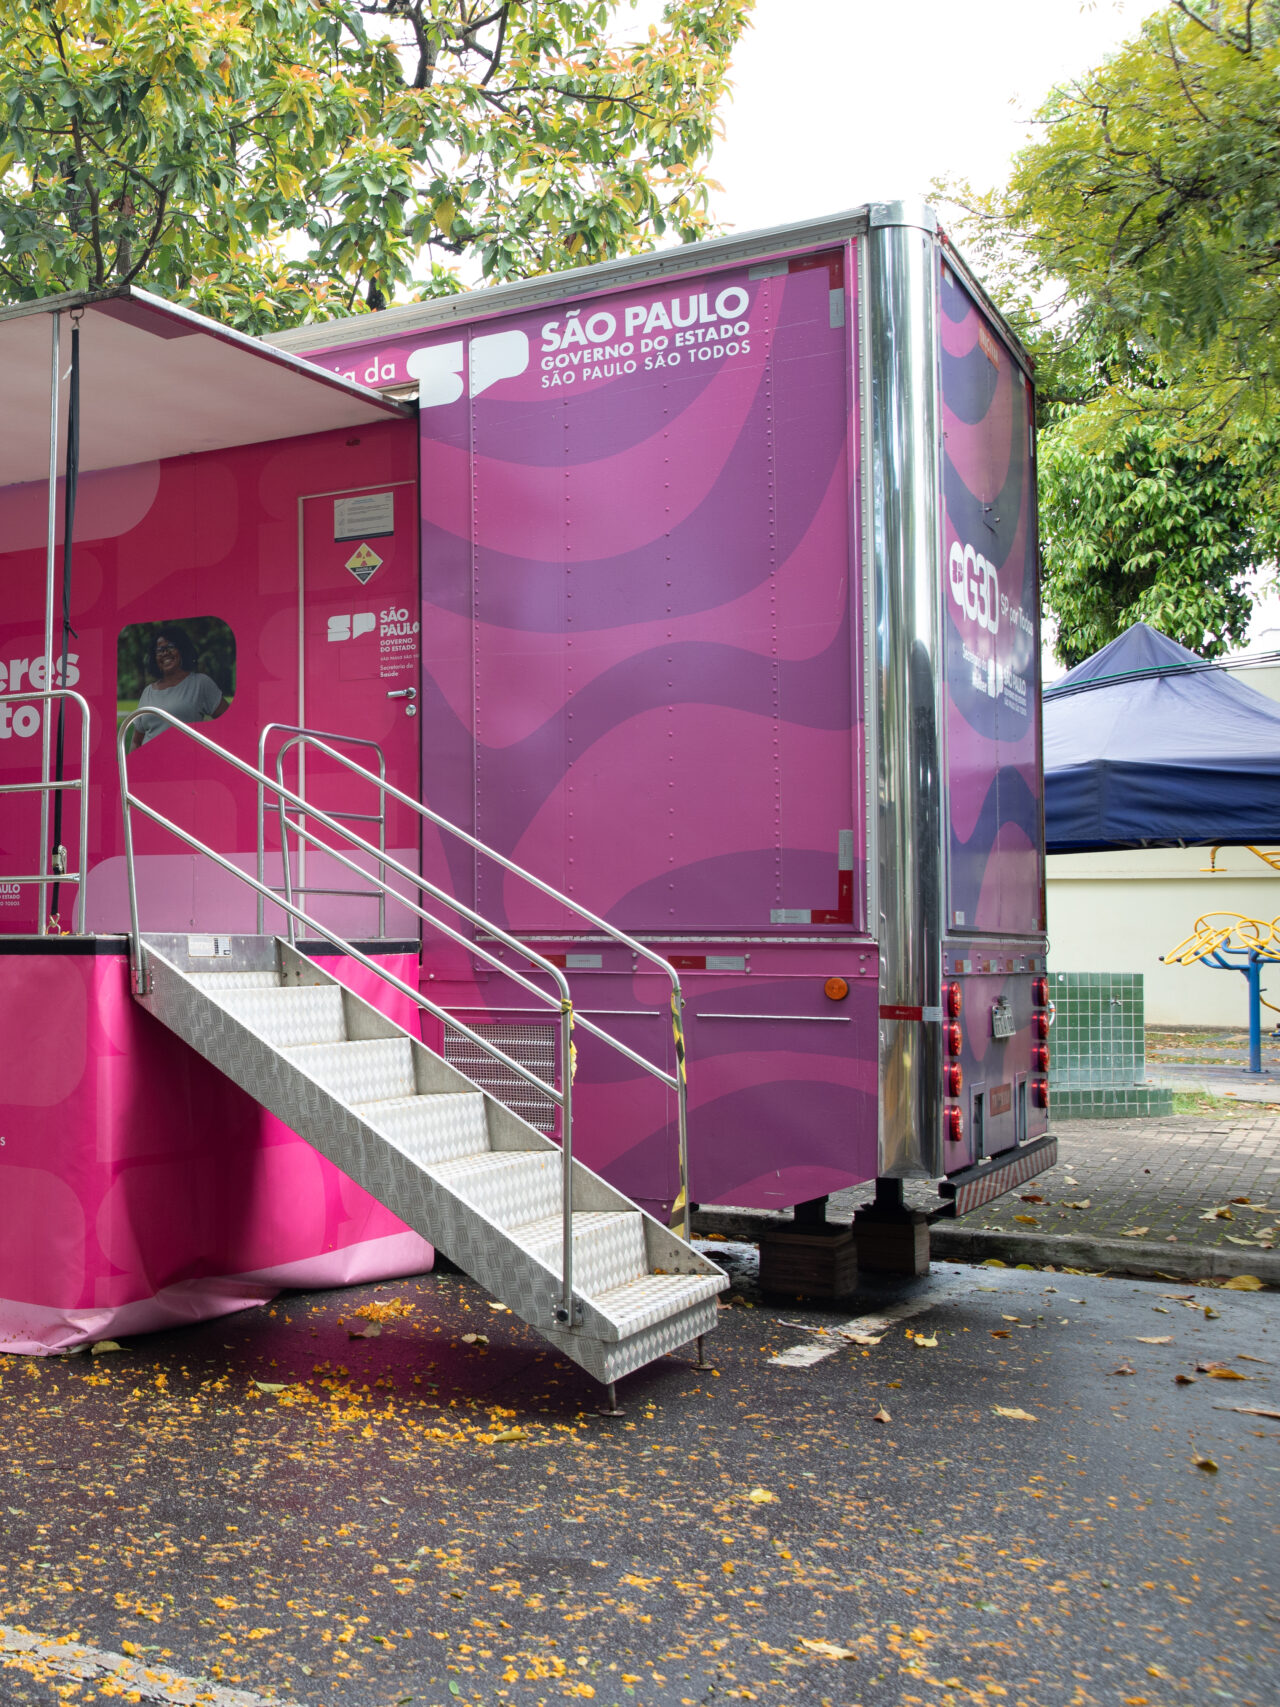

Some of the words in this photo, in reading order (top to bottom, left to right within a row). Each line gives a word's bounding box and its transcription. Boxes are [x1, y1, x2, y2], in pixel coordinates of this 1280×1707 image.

[541, 308, 617, 352] SÃO
[625, 286, 750, 337] PAULO
[541, 342, 635, 371] GOVERNO
[640, 335, 669, 353] DO
[675, 321, 750, 347] ESTADO
[365, 356, 395, 383] da
[541, 370, 576, 389] SÃO
[582, 360, 637, 381] PAULO
[644, 352, 681, 370] SÃO
[688, 340, 751, 363] TODOS
[327, 612, 377, 643] SP
[380, 606, 409, 623] SÃO
[380, 638, 413, 646] GOVERNO
[392, 644, 417, 652] ESTADO
